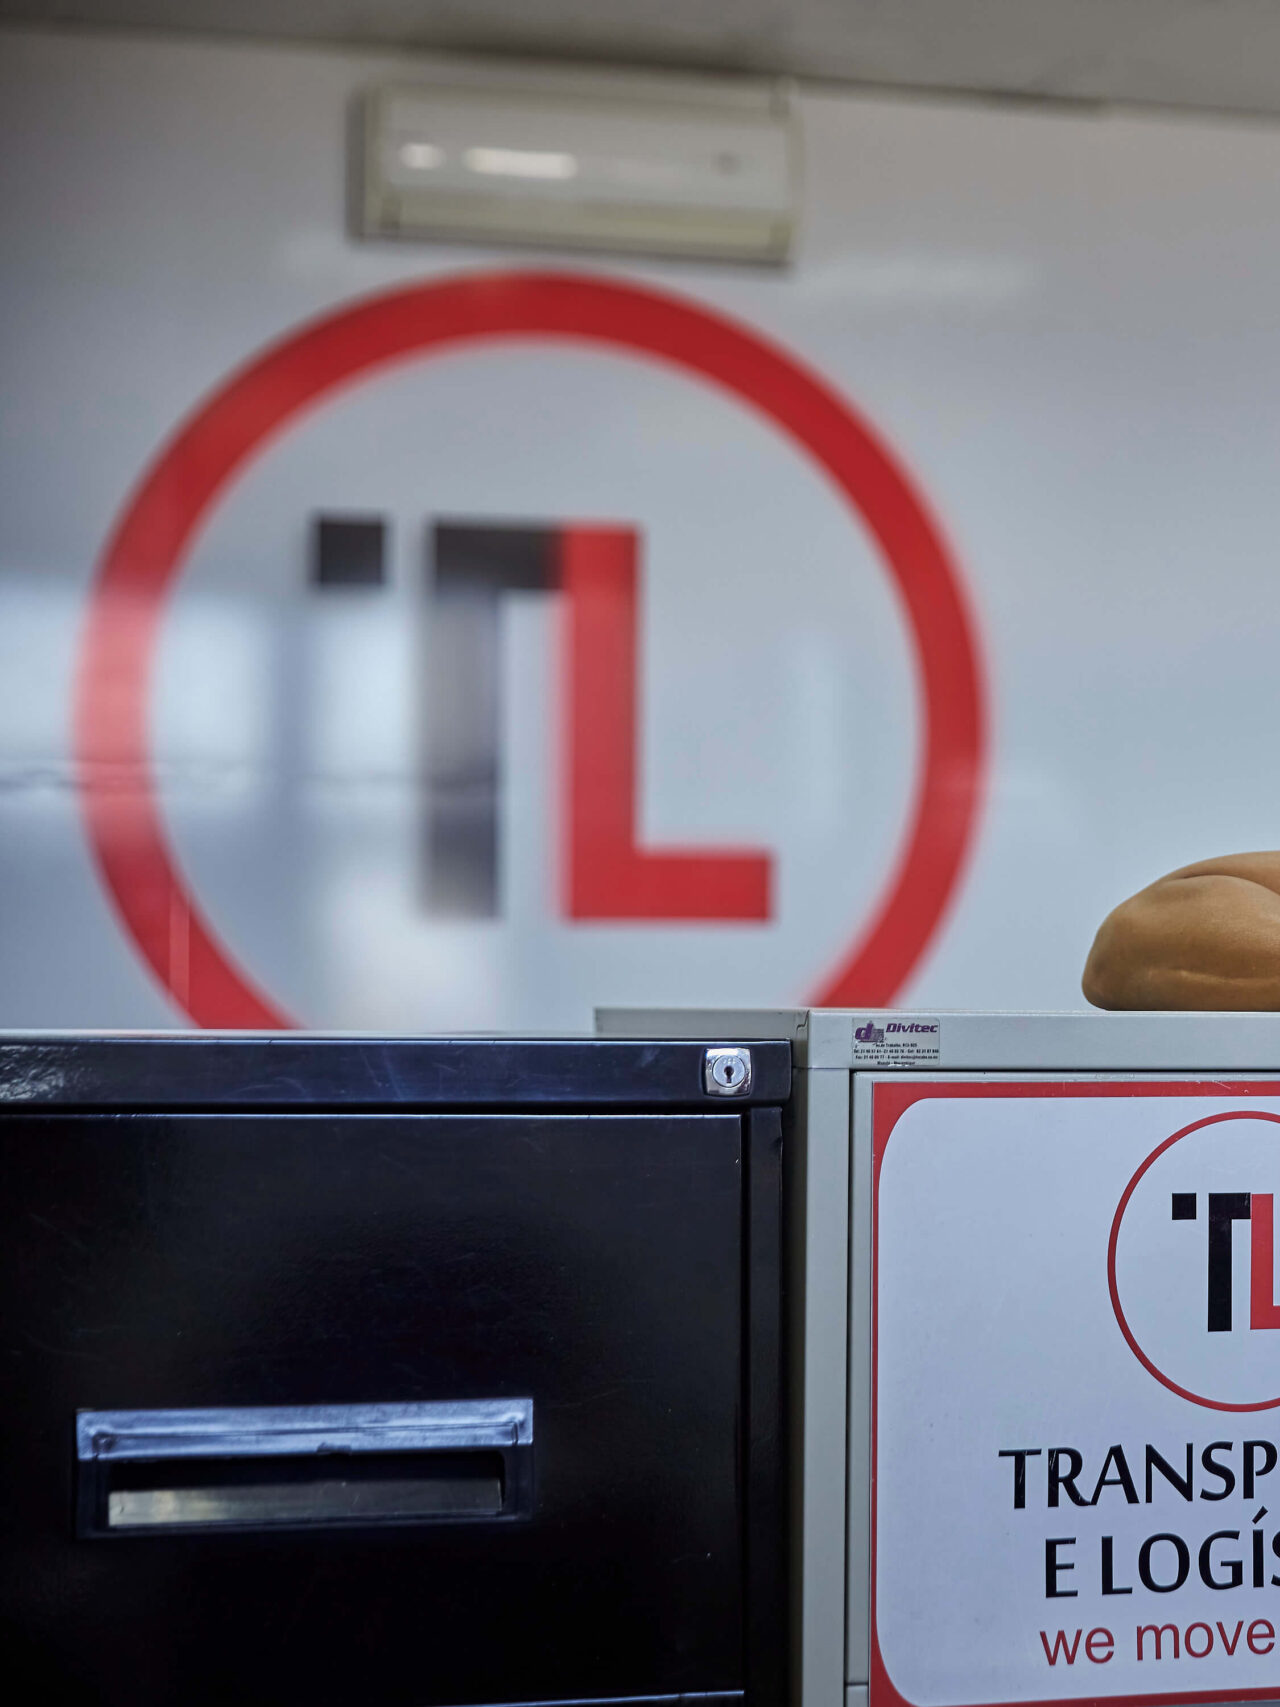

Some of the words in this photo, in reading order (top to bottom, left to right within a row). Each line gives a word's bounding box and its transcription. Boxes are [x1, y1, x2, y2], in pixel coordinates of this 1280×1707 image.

[886, 1022, 939, 1033] Divitec
[1045, 1537, 1079, 1599] E
[1039, 1627, 1115, 1666] we
[1136, 1619, 1276, 1661] move
